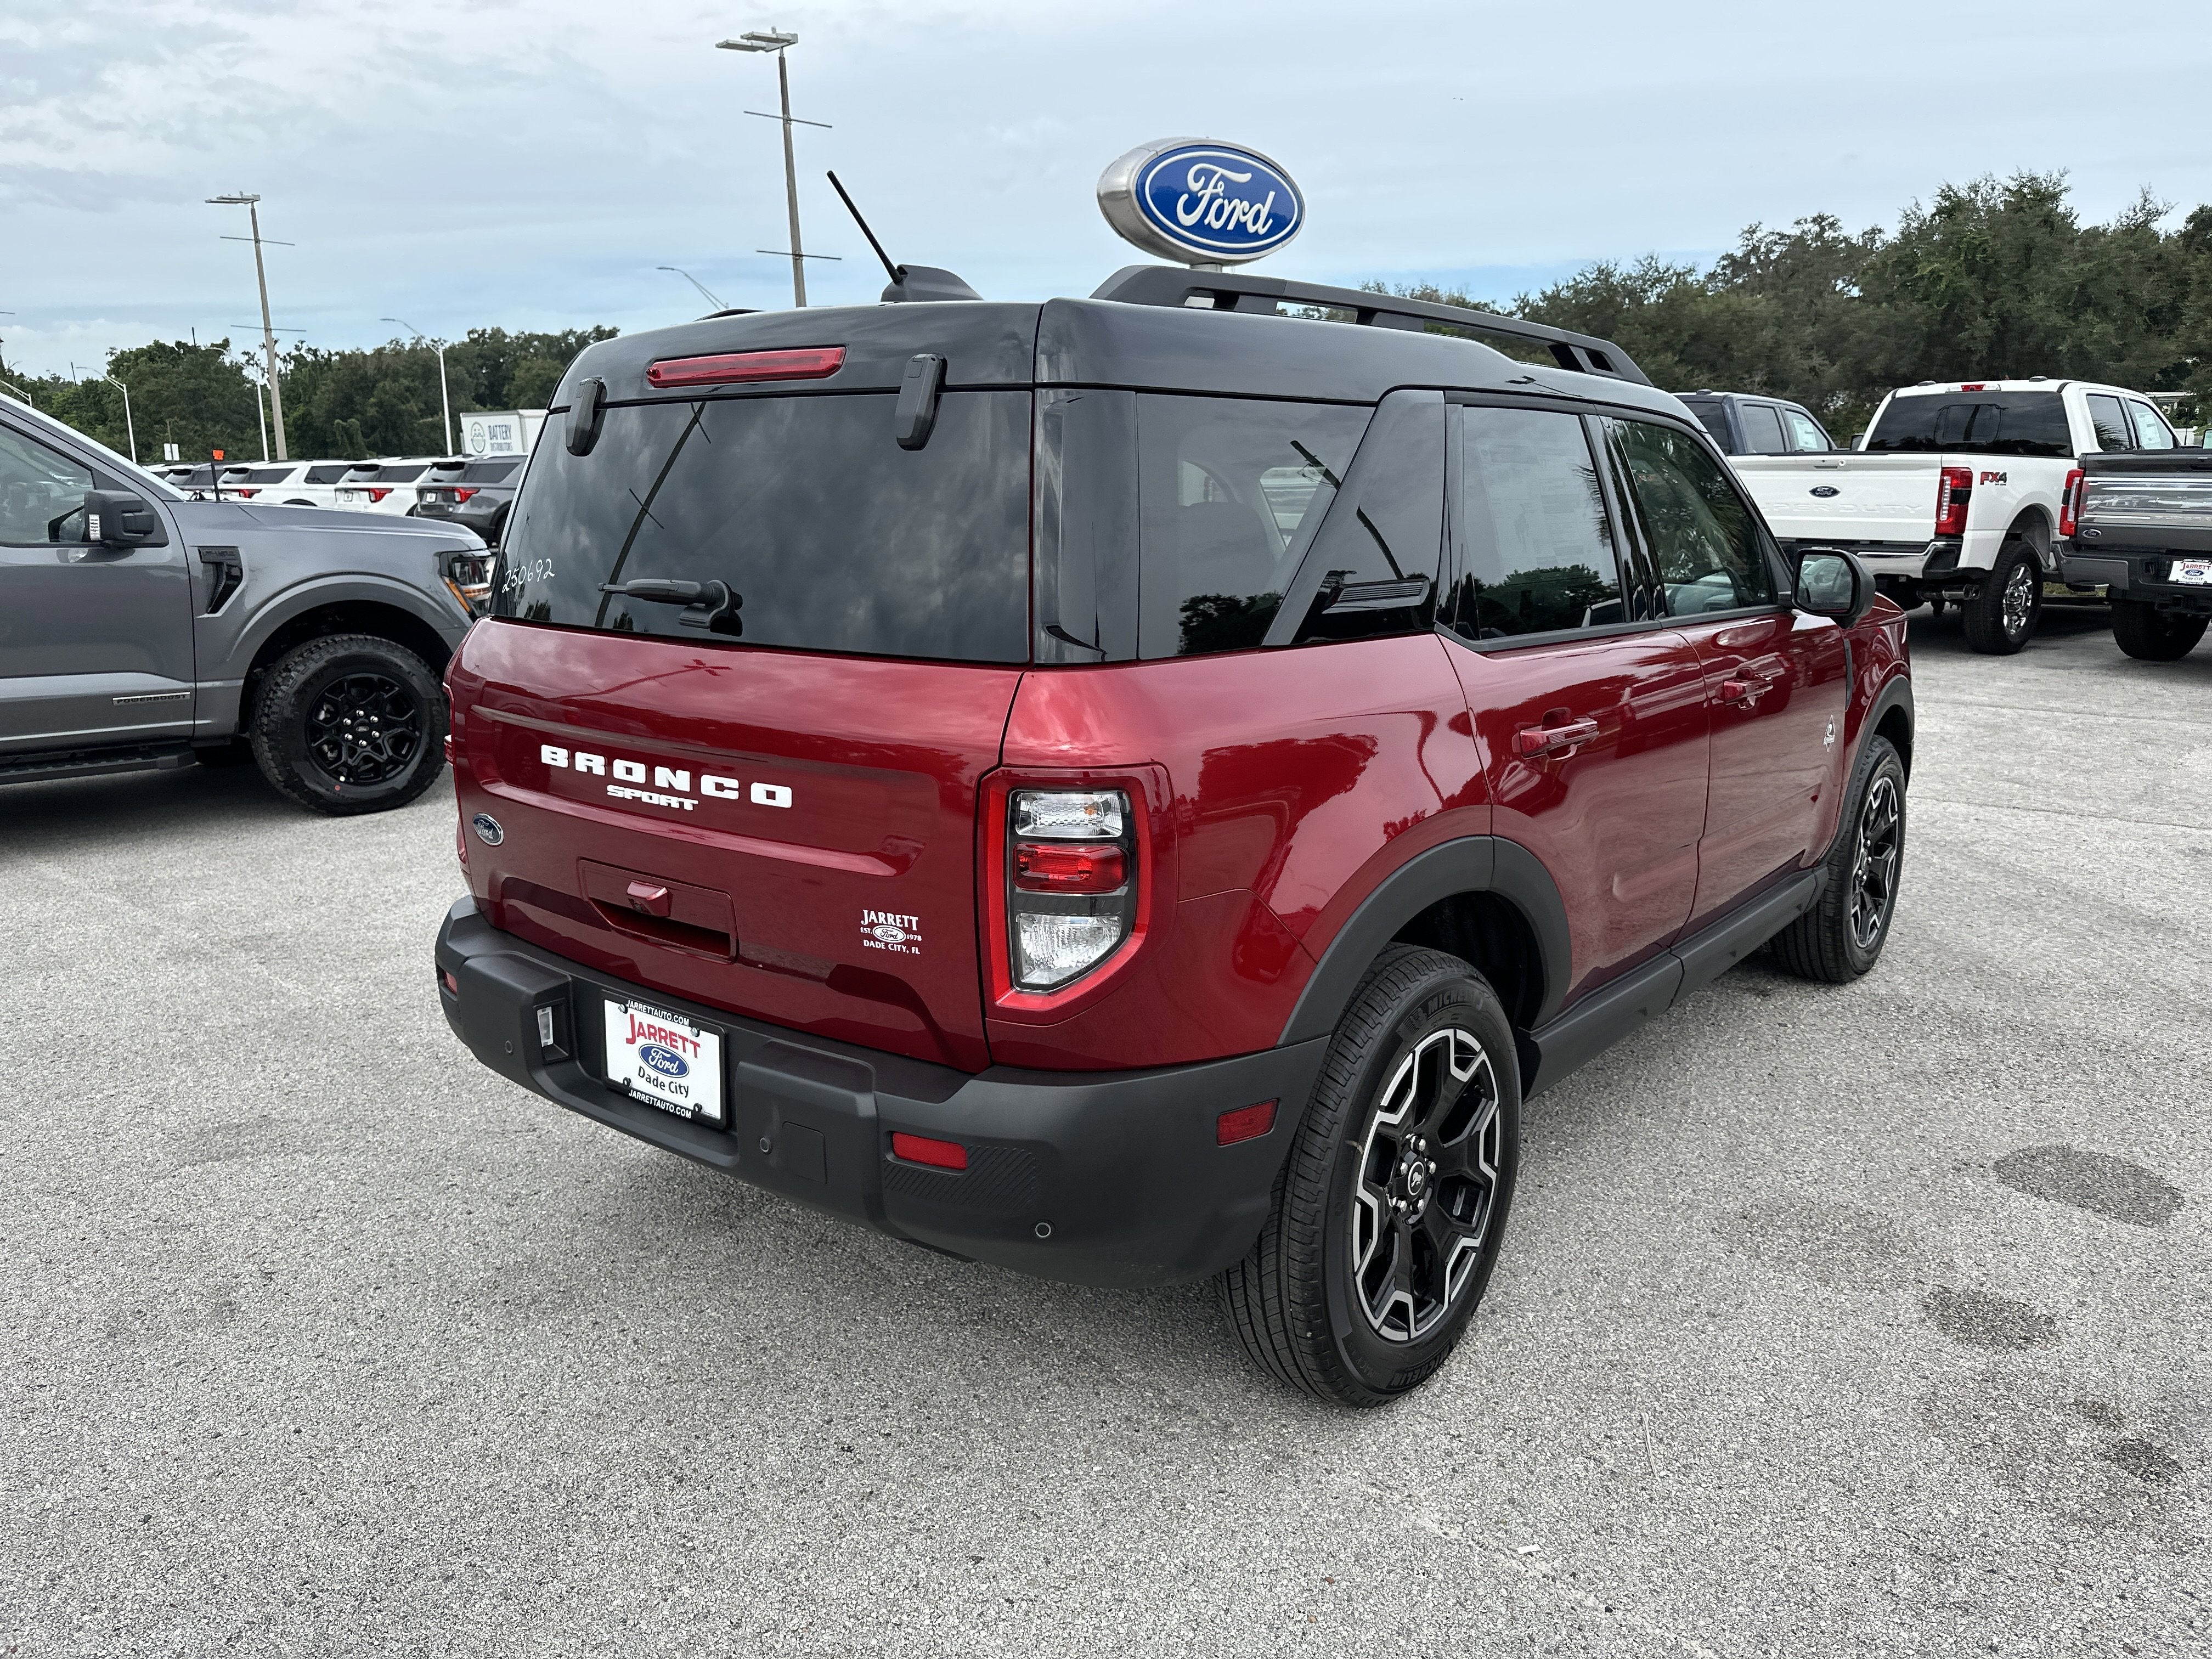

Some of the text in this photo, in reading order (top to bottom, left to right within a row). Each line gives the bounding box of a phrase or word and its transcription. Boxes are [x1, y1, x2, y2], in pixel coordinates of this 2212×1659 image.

[1177, 163, 1276, 235] Ford
[488, 425, 512, 440] BATTERY
[1980, 471, 2007, 485] FX4
[1758, 502, 1922, 514] UPER DUTY
[501, 558, 555, 594] 250692
[2180, 562, 2211, 571] JARRETT
[116, 694, 186, 704] POWERBOOST
[541, 744, 792, 809] BRONCO
[607, 785, 699, 811] SPORT
[477, 819, 494, 839] Ford
[860, 909, 919, 931] JARRETT
[880, 928, 899, 939] Ford
[863, 939, 921, 955] DADE CITY, FL
[626, 1000, 690, 1026] JARRETTAUTO.COM
[1428, 989, 1480, 1015] MICHEL
[625, 1013, 701, 1059] JARRETT
[648, 1048, 679, 1074] Ford
[637, 1065, 689, 1098] Dade City
[629, 1089, 691, 1119] JARRETTAUTO.COM
